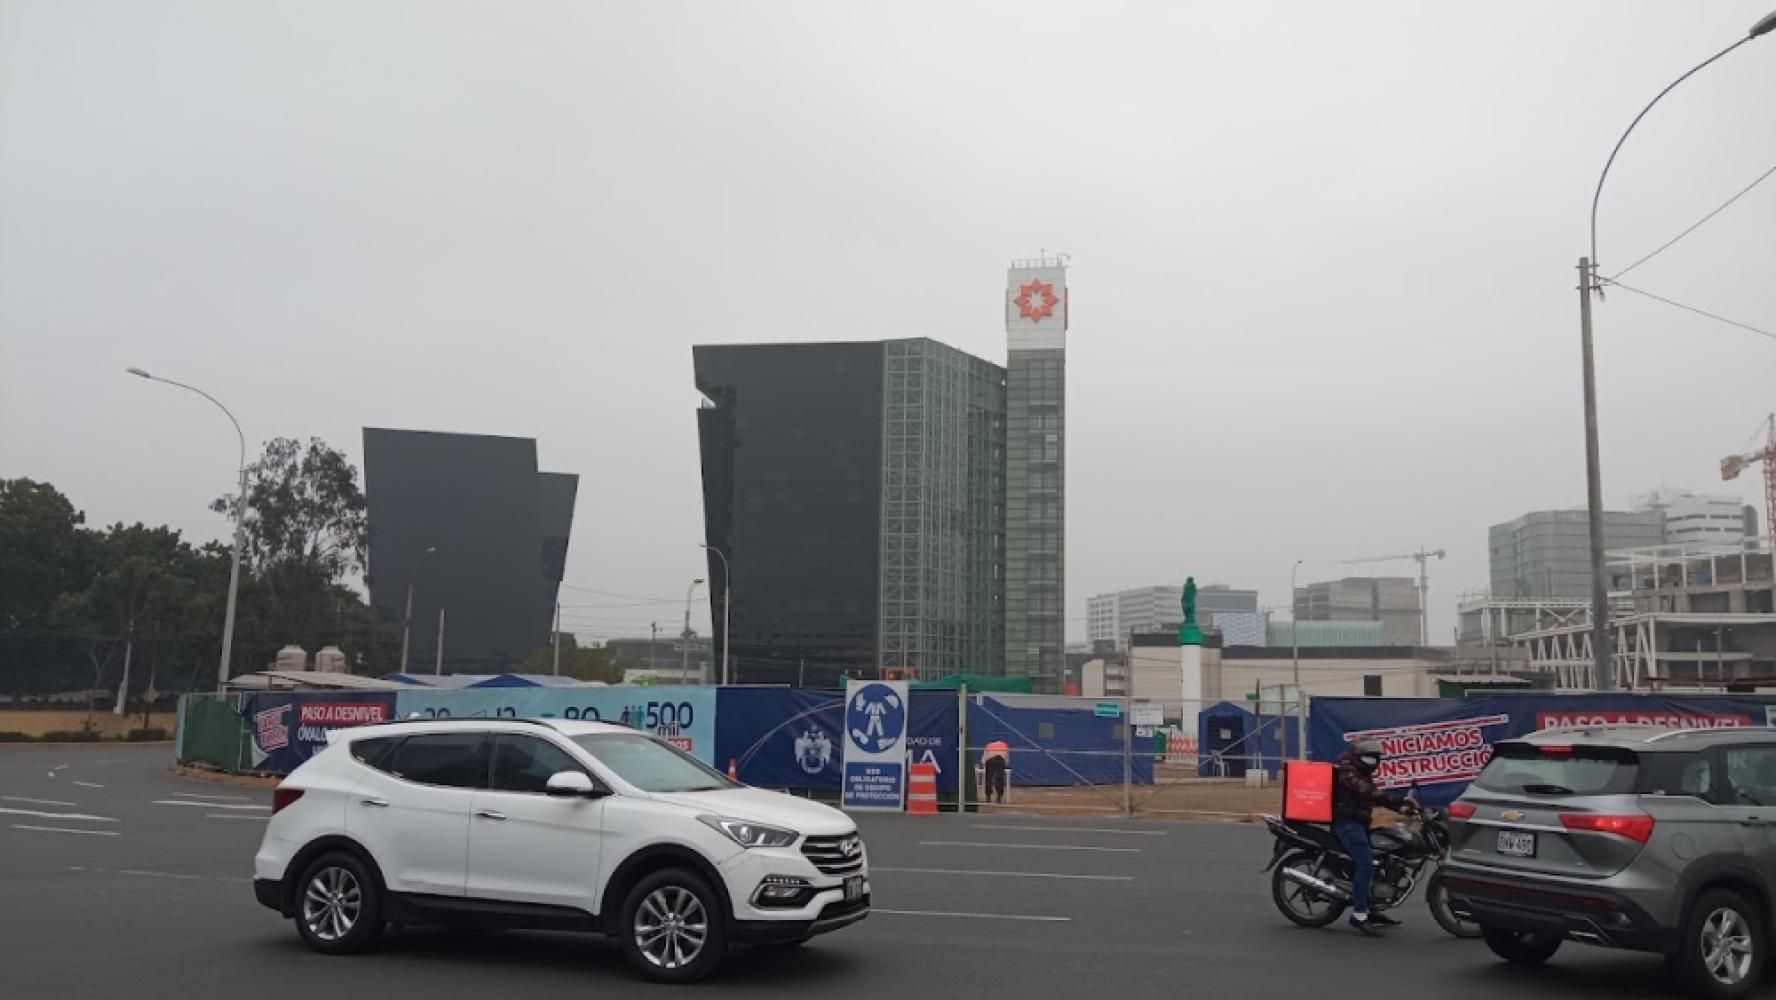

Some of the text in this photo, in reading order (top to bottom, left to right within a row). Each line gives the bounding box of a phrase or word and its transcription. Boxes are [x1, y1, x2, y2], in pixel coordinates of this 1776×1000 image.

[301, 706, 325, 721] PASO
[326, 706, 334, 721] A
[335, 706, 383, 722] DESNIVEL
[646, 701, 694, 729] 500
[657, 721, 679, 737] mil
[1381, 729, 1481, 755] NICIAMOS
